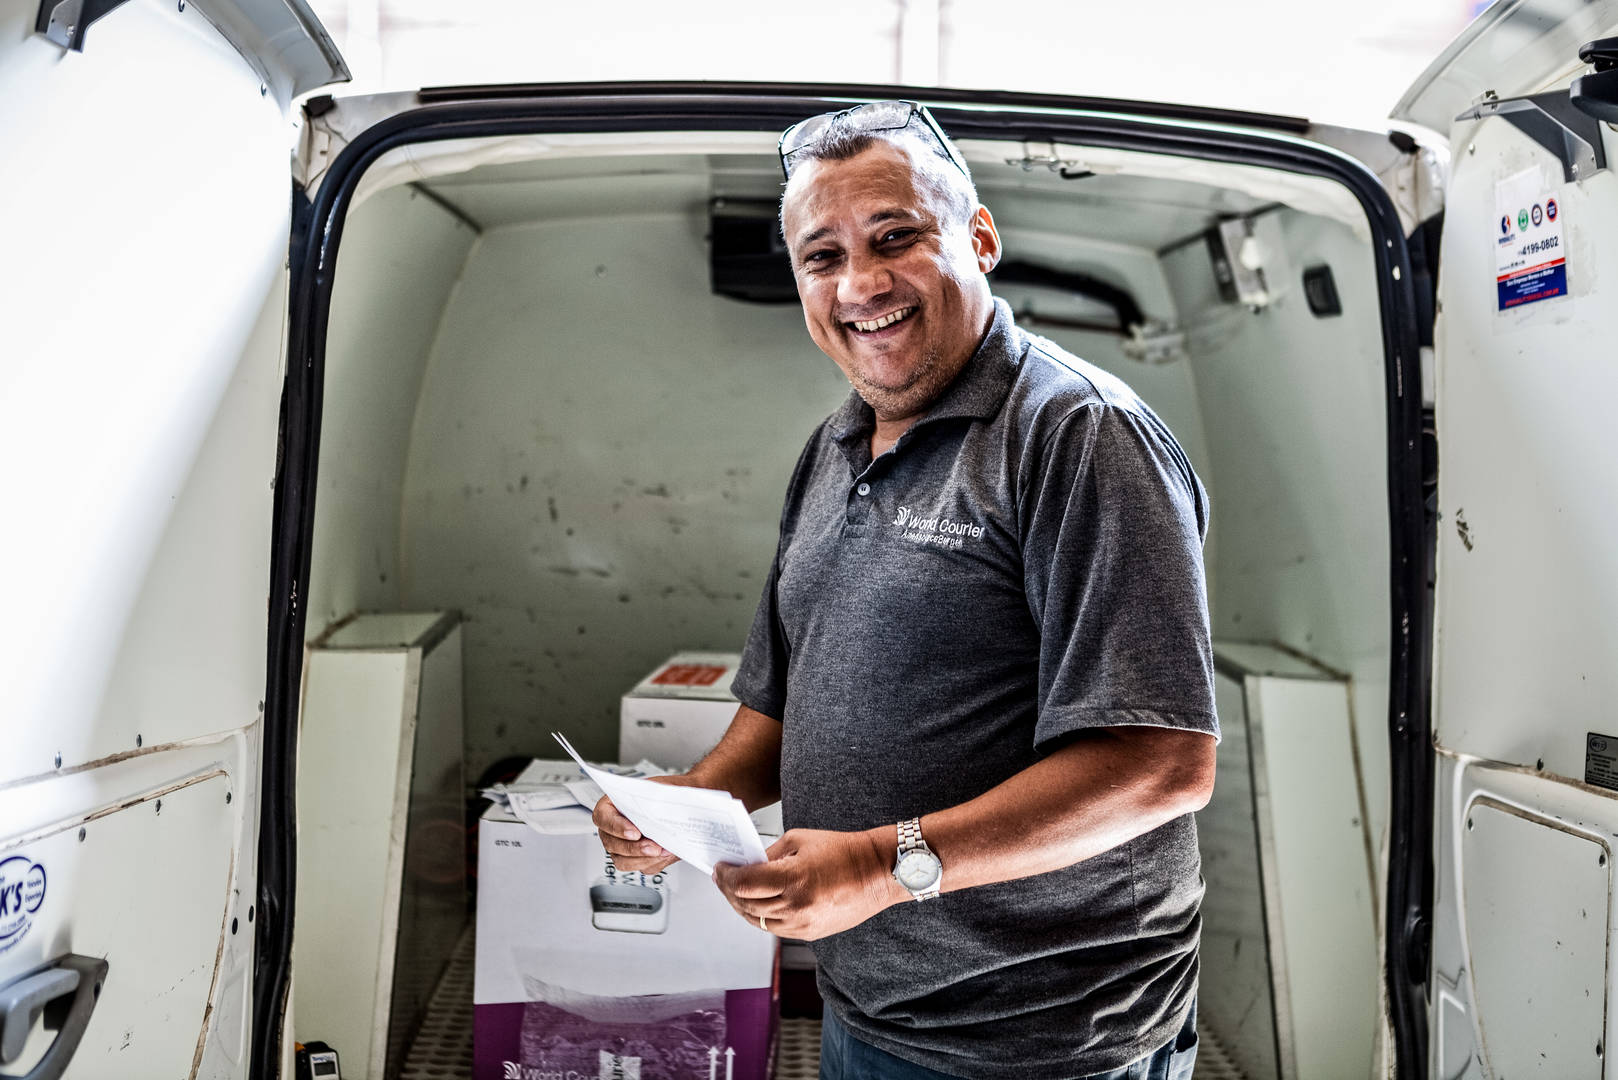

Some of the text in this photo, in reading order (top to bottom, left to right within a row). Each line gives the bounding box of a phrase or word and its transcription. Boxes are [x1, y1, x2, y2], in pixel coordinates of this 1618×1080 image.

[1522, 235, 1559, 256] 4199-0802
[908, 514, 985, 538] World Courier
